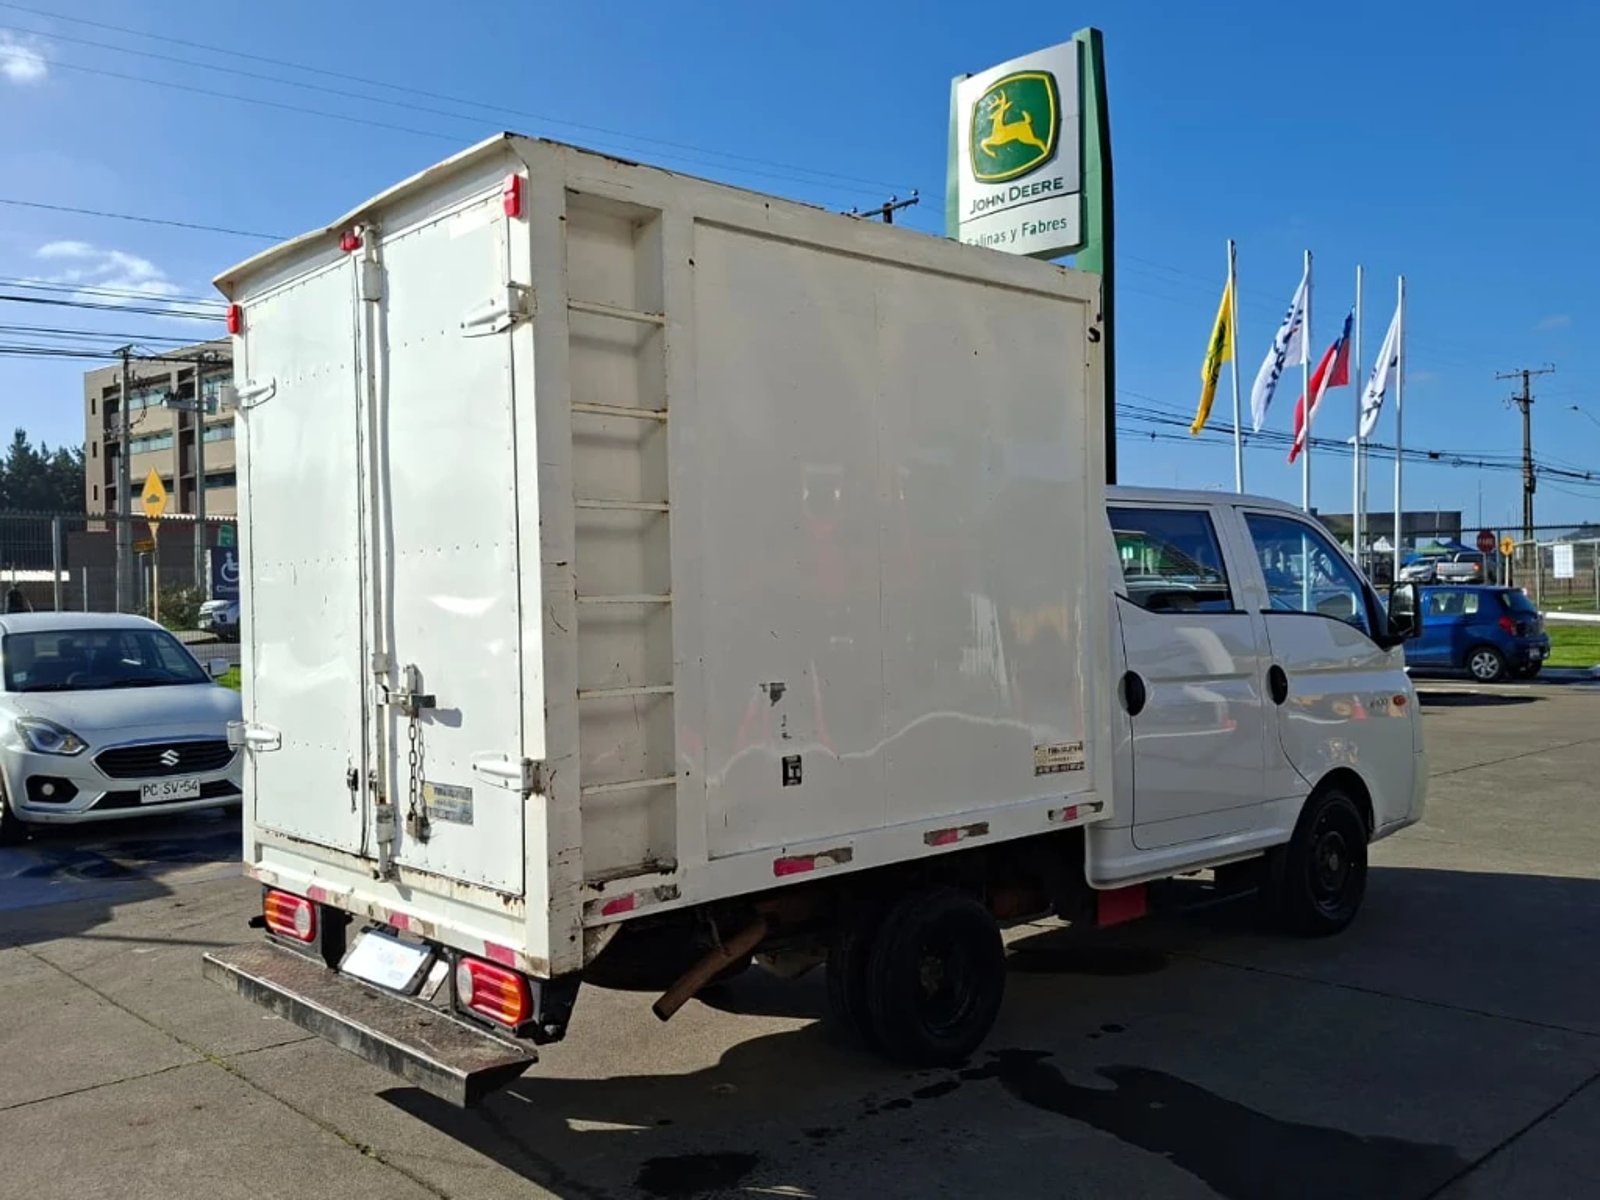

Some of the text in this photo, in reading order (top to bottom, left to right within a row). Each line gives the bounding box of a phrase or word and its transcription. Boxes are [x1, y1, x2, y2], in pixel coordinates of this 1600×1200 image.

[970, 177, 1064, 214] JOHN DEERE
[1010, 228, 1017, 243] y
[1021, 218, 1067, 237] Fabres
